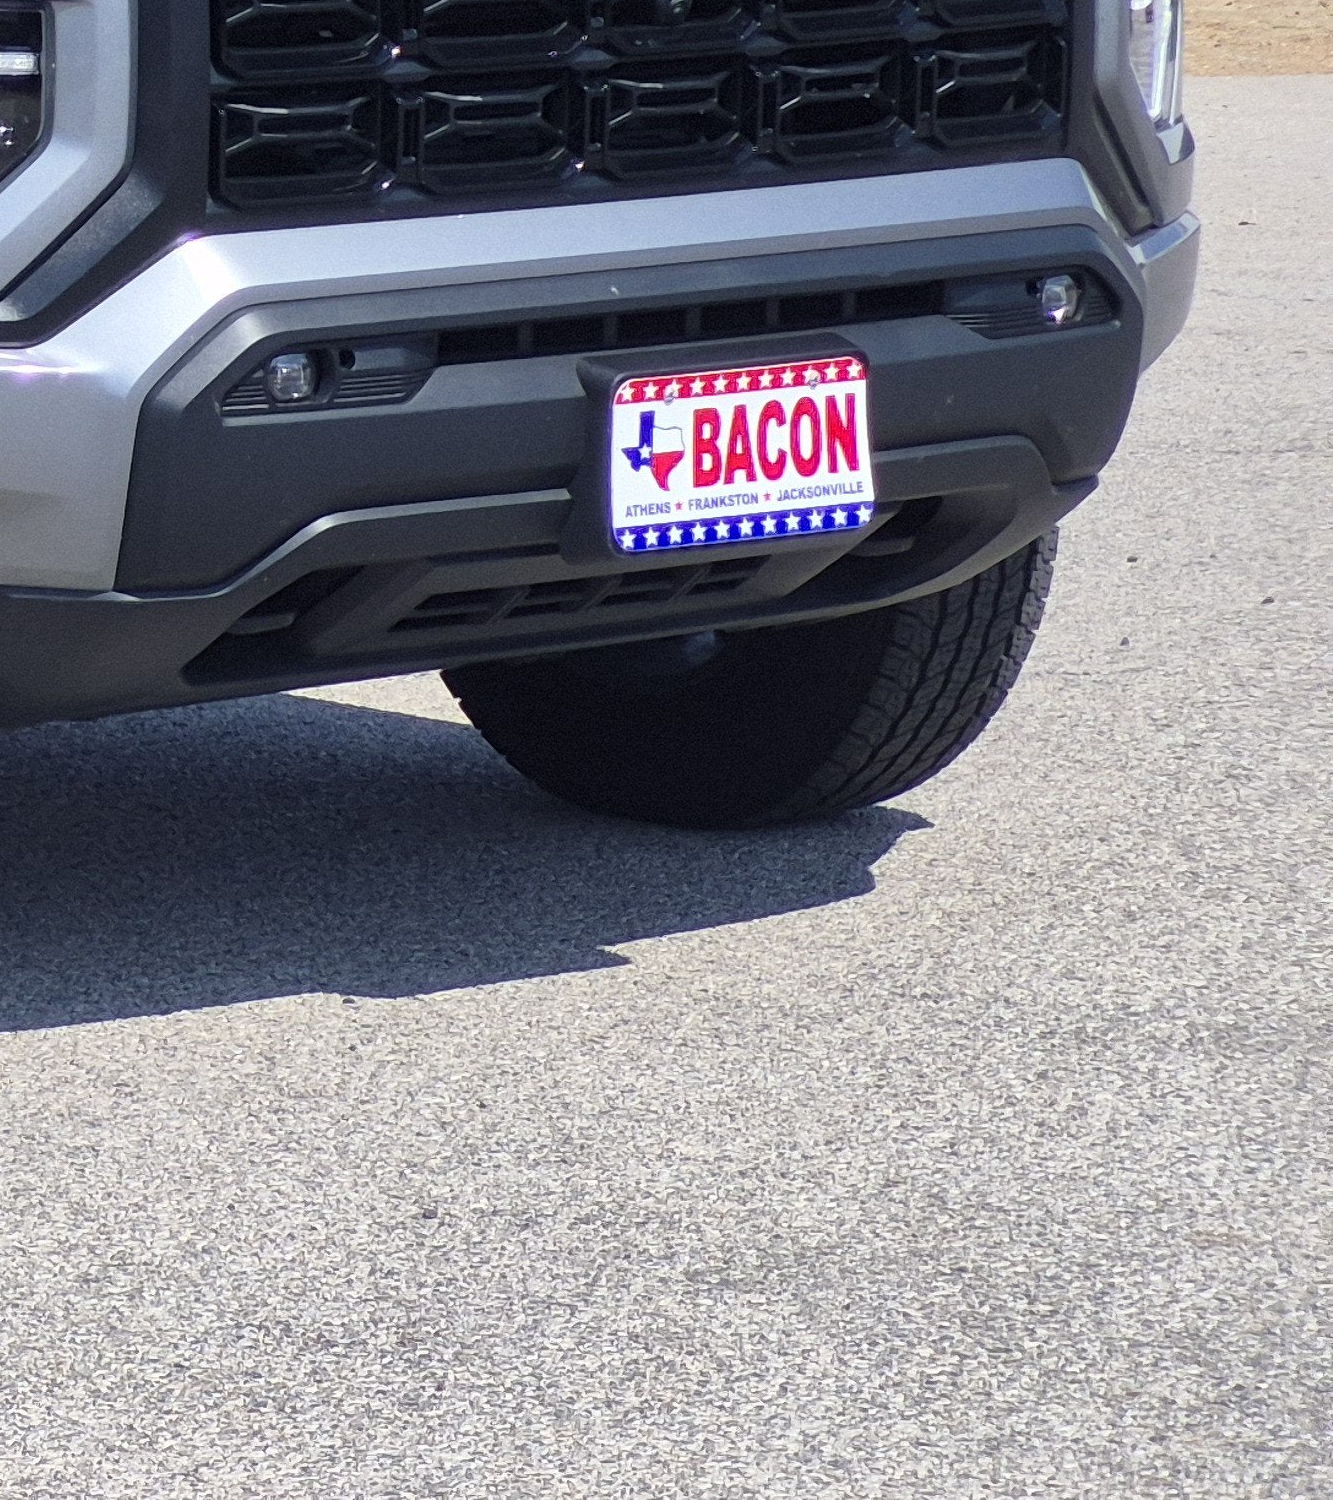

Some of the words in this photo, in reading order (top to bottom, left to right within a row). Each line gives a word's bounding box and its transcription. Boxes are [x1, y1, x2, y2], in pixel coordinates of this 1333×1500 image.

[692, 392, 861, 489] BACON
[625, 501, 672, 518] ATHENS
[687, 492, 759, 512] FRANKSTON
[776, 480, 864, 502] JACKSONVILLE
